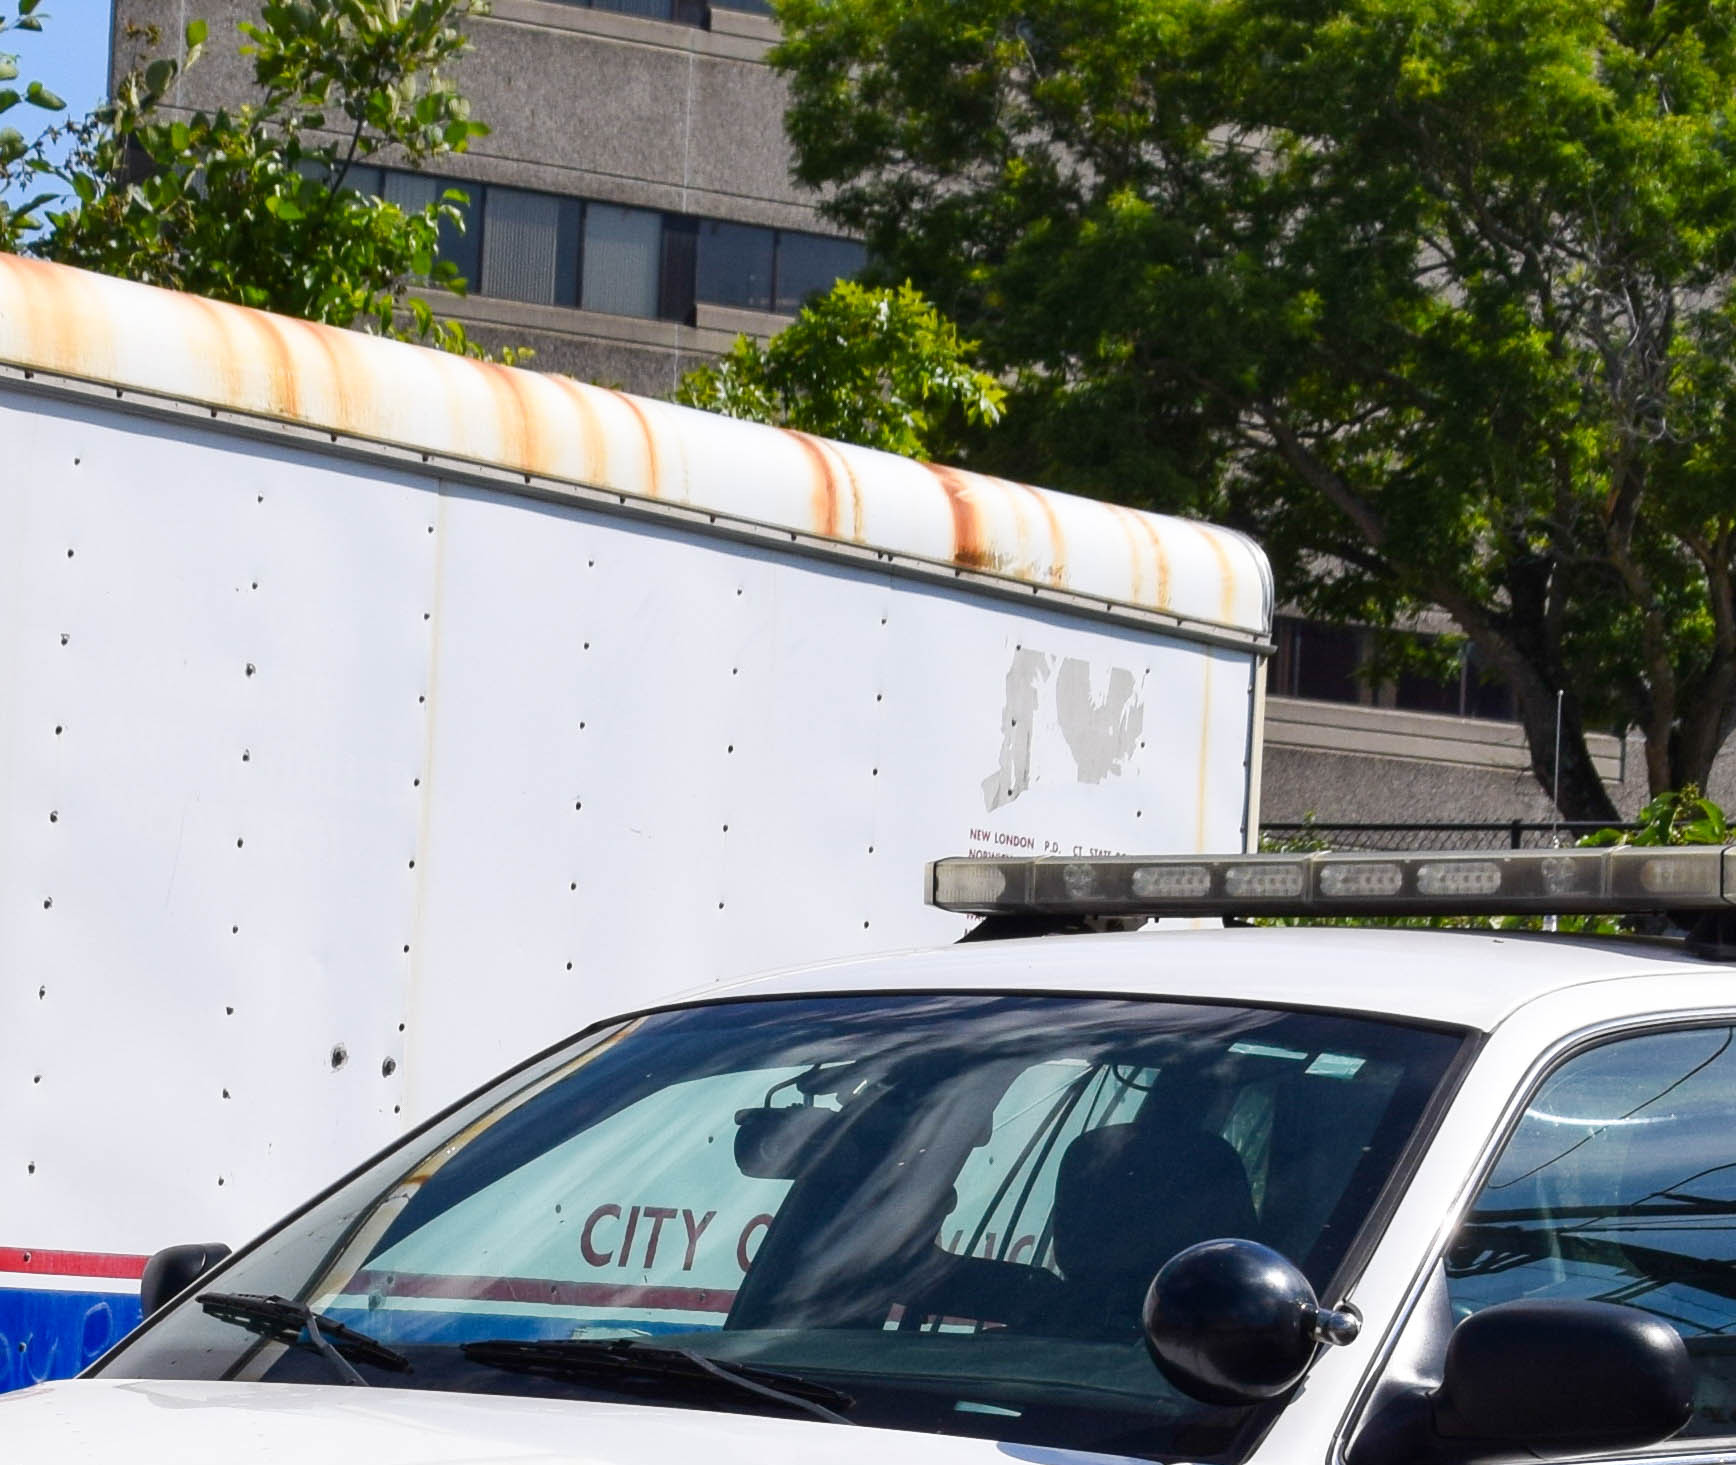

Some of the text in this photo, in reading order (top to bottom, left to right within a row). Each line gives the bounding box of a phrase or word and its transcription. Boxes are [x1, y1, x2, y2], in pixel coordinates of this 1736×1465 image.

[969, 828, 991, 842] NEW
[994, 832, 1035, 849] LONDON
[579, 1203, 718, 1272] CITY
